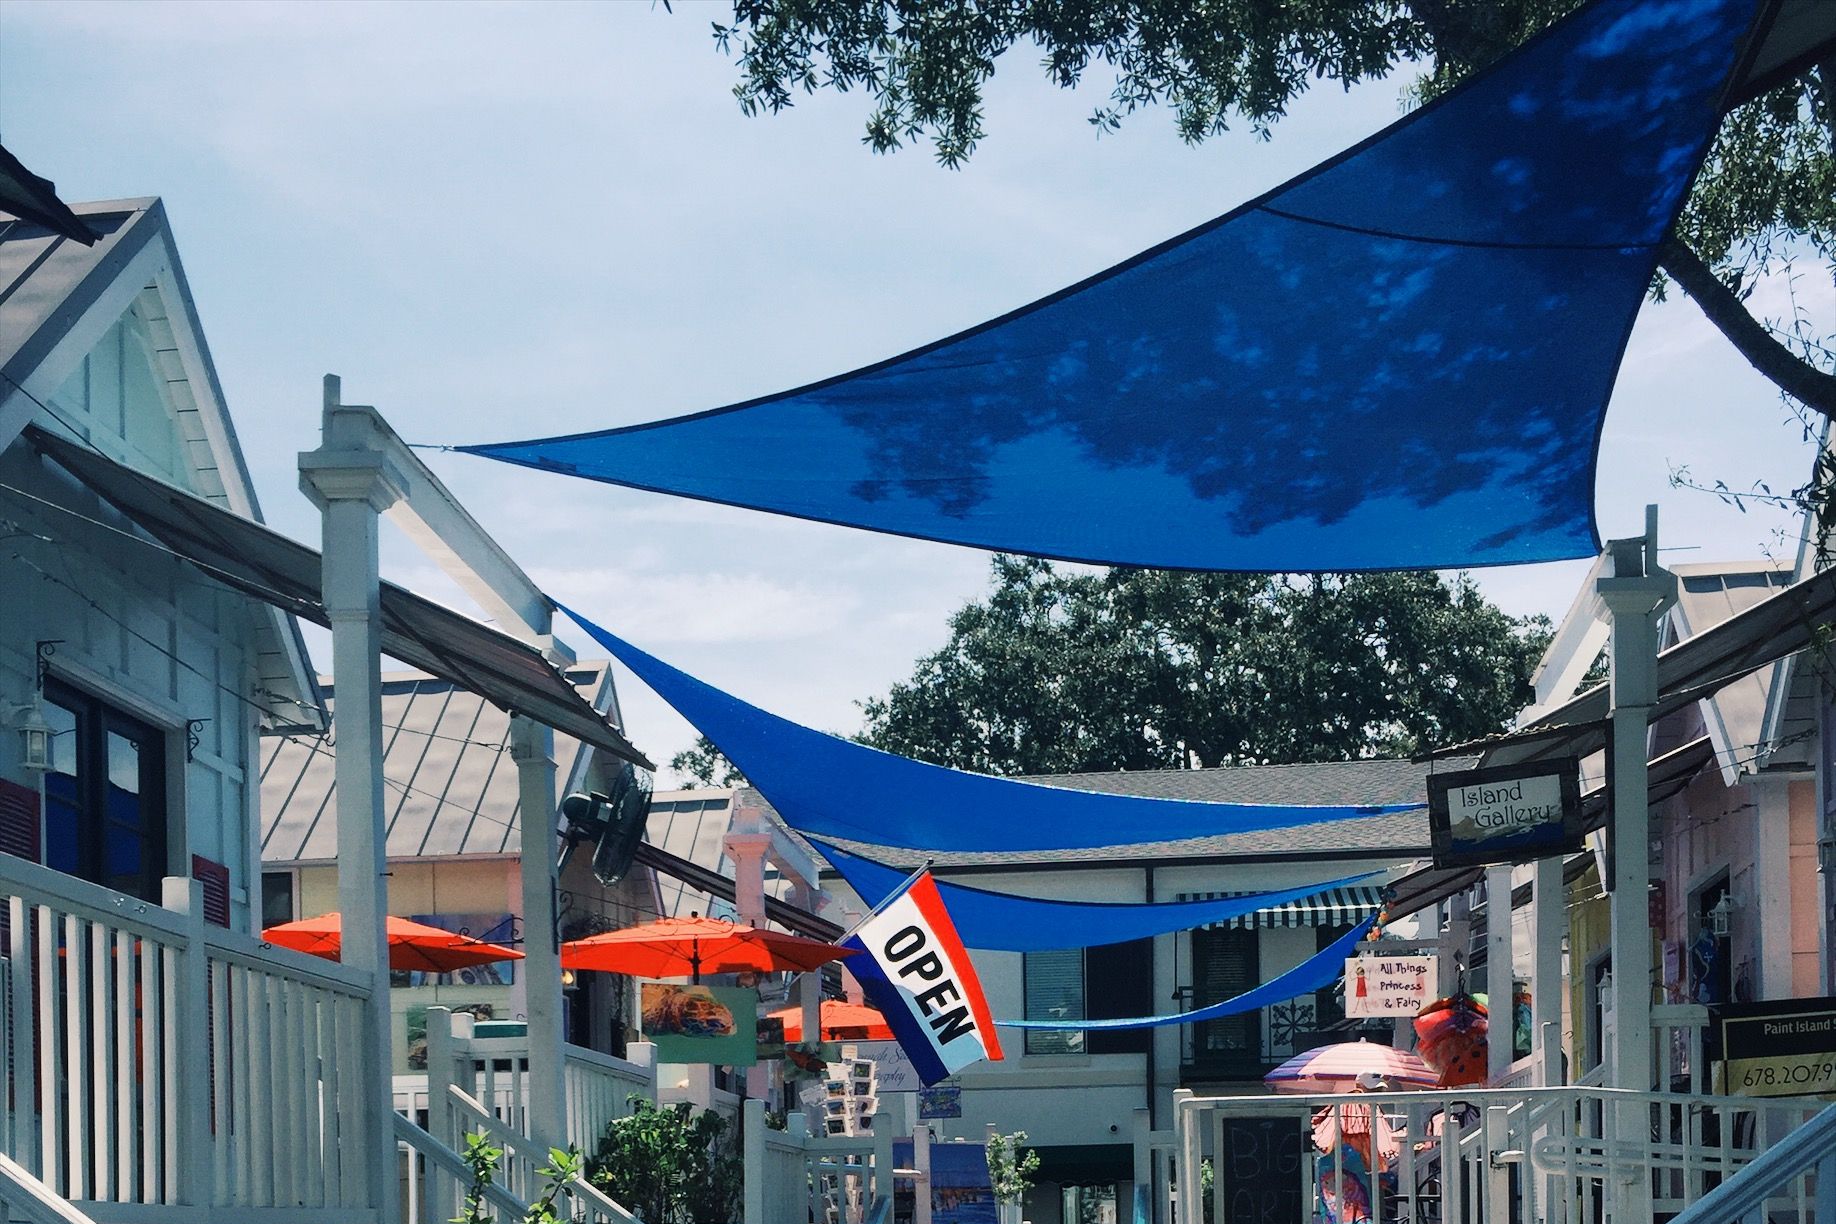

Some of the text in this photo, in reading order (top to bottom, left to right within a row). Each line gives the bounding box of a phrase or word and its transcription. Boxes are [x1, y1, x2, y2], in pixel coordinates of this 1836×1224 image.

[1460, 780, 1523, 808] Island
[1475, 804, 1550, 829] Gallery
[1380, 962, 1428, 977] All Things
[884, 925, 976, 1046] OPEN
[1380, 980, 1422, 992] Princess
[1384, 997, 1421, 1011] & Fairy
[1764, 1021, 1793, 1036] Paint
[1795, 1018, 1831, 1033] Island
[1743, 1062, 1836, 1087] 678.207.9
[1230, 1121, 1300, 1180] BIG
